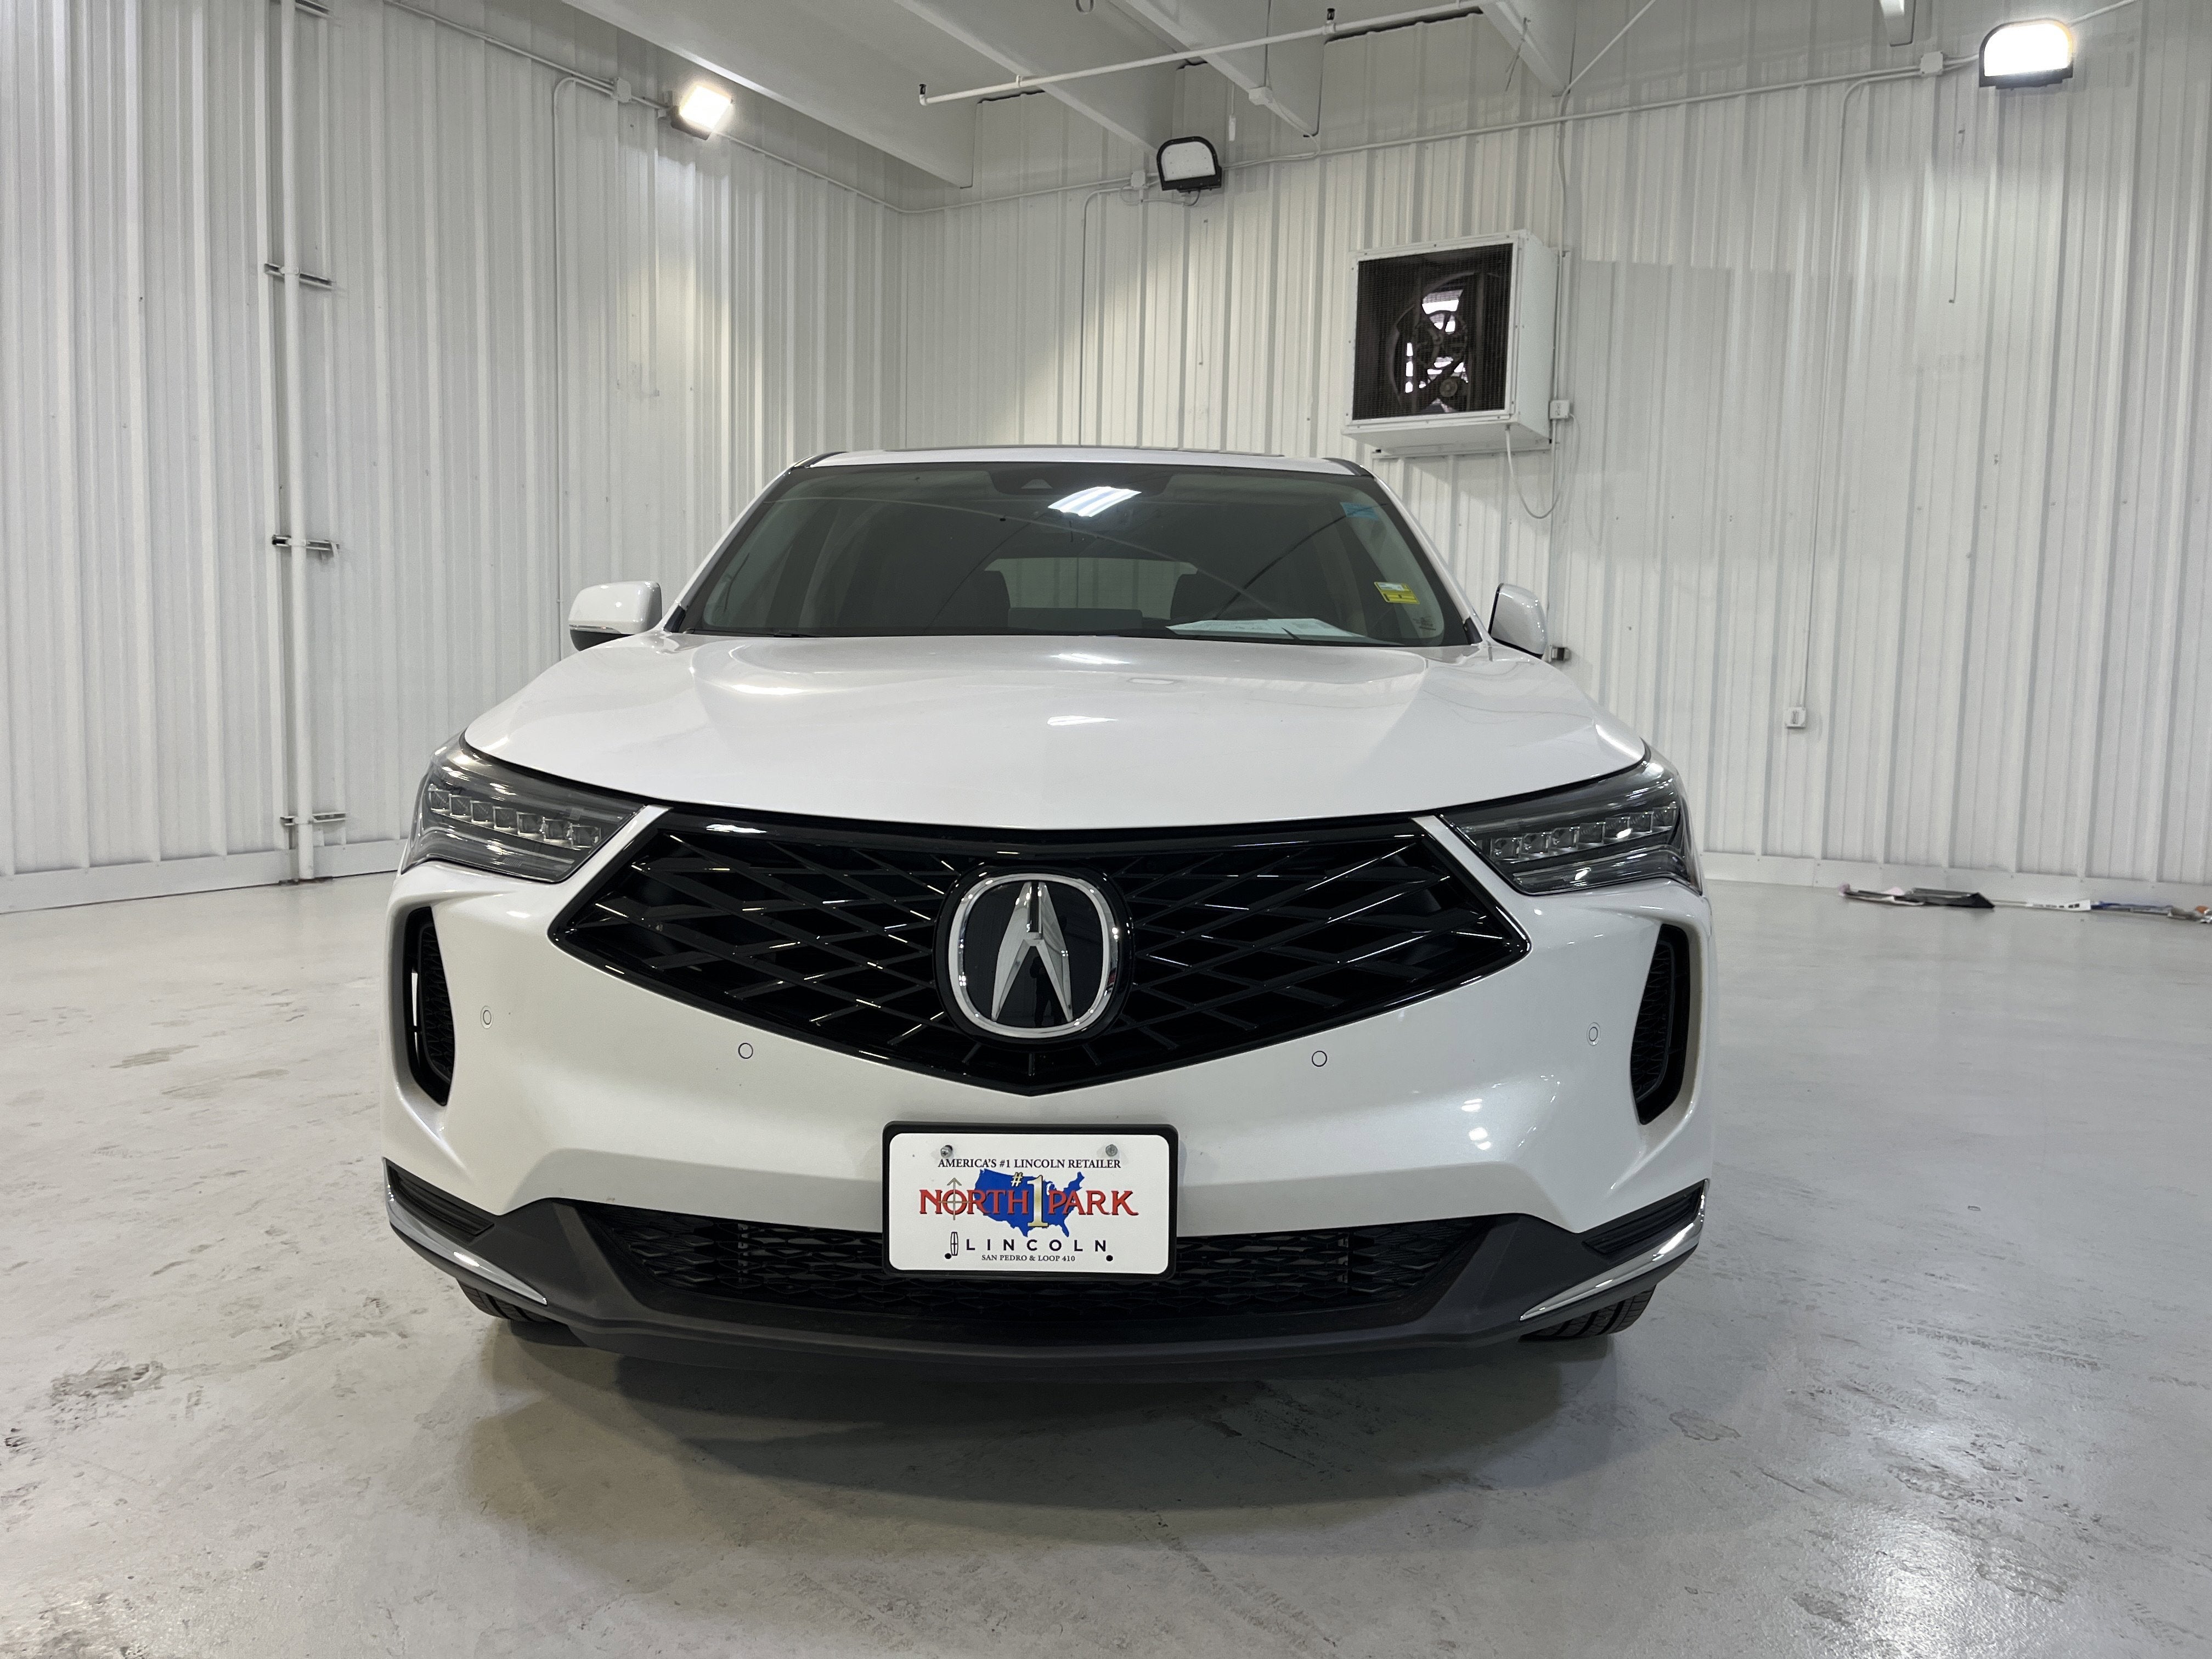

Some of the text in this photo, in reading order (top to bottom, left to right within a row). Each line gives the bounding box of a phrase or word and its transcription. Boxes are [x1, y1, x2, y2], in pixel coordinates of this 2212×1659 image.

[938, 1159, 1121, 1169] AMERICA'S #1 LINCOLN RETAILER
[919, 1189, 1139, 1216] NORTH PARK
[966, 1239, 1107, 1252] LINCOLN
